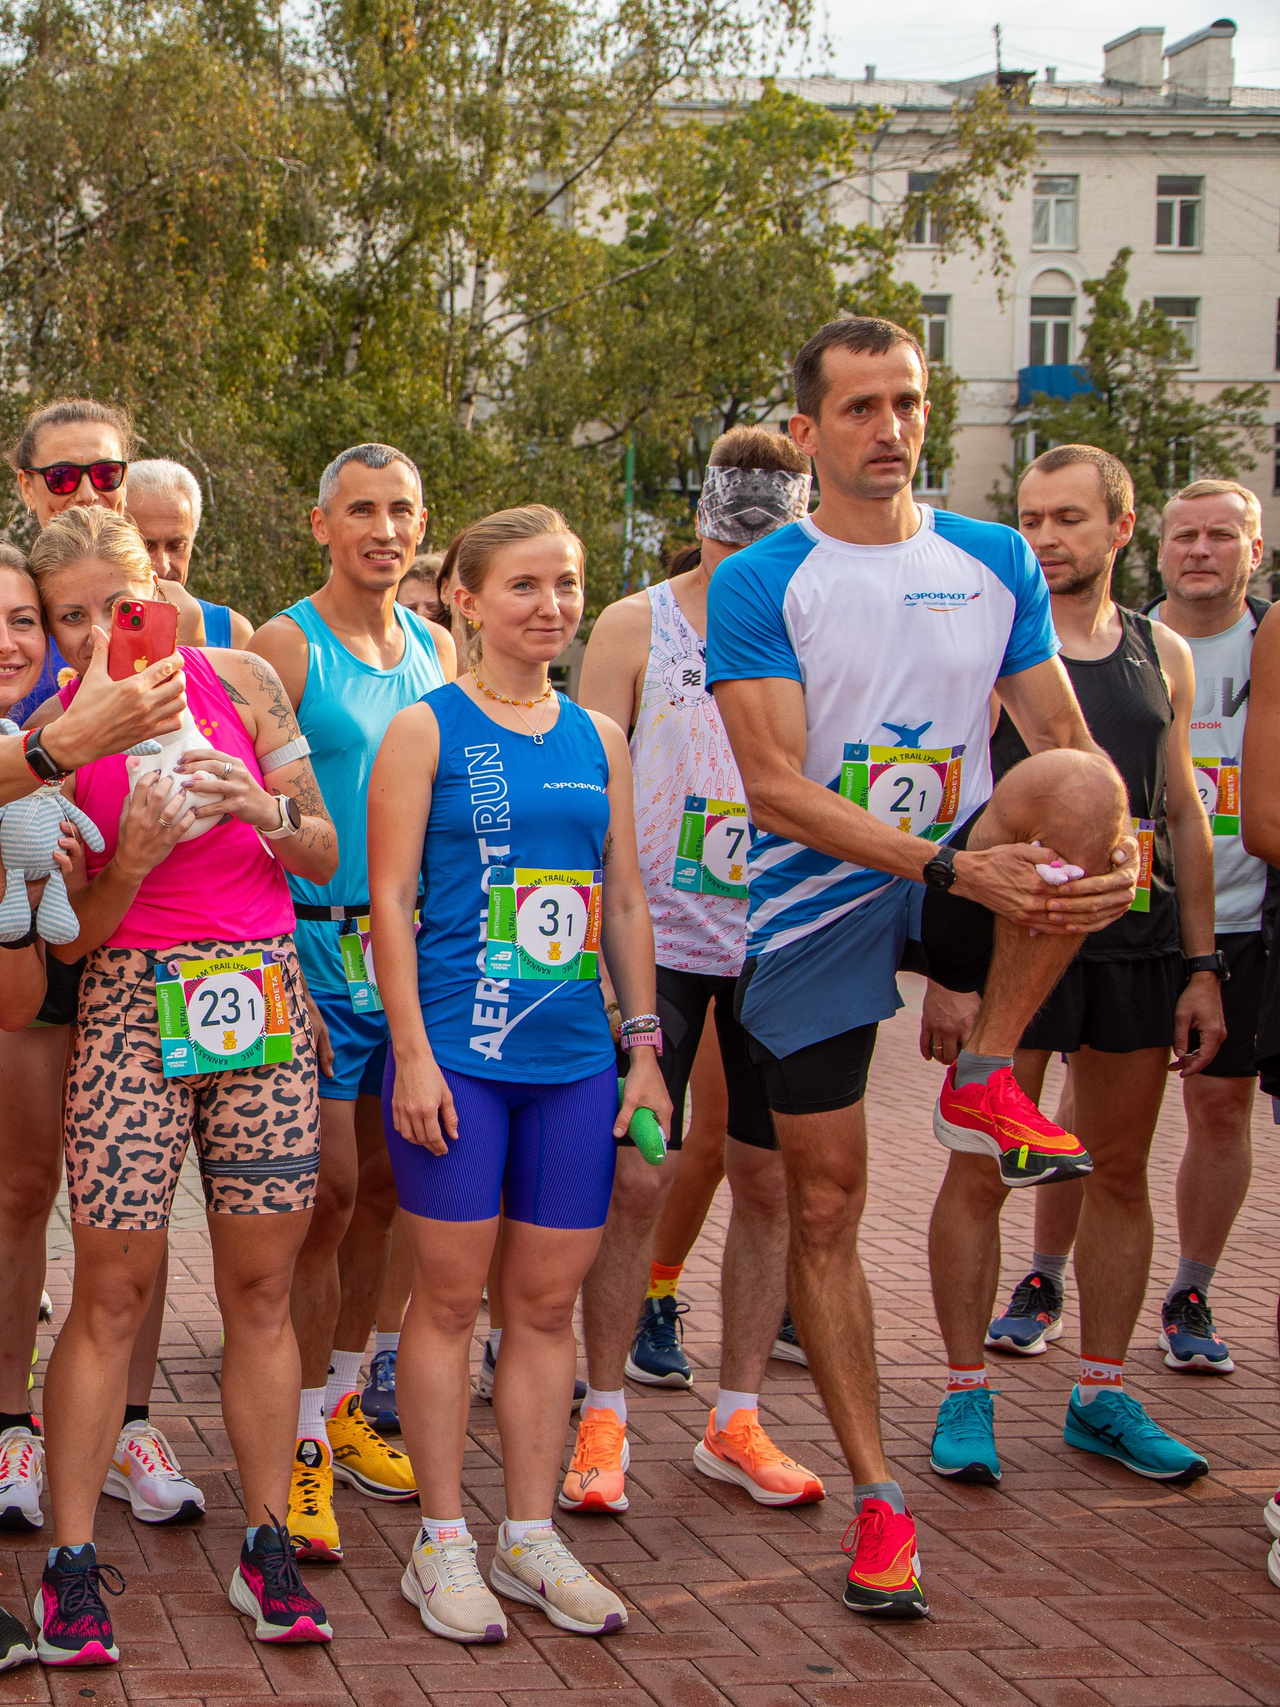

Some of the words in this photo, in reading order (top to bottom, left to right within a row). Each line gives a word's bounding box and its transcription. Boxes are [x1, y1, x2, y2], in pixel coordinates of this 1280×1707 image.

[903, 592, 967, 601] АЭРОФЛОТ
[872, 756, 898, 776] DREAM
[899, 753, 922, 761] TRAIL
[465, 743, 510, 834] RUN
[543, 782, 602, 792] АЭРОФЛОТ
[948, 768, 958, 815] ЭСТАФЕТА
[707, 809, 731, 826] DREAM
[1140, 840, 1149, 881] ЭСТАФЕТА
[518, 878, 542, 899] DREAM
[544, 874, 565, 882] TRAIL
[566, 876, 588, 899] LYSKOVO
[705, 874, 730, 892] KANNAS
[509, 910, 517, 932] TRAIL
[592, 896, 600, 943] ЭСТАФЕТА
[522, 955, 551, 975] KANNAS
[562, 965, 574, 974] ЛЕС
[186, 968, 209, 993] DREAM
[209, 962, 231, 972] TRAIL
[233, 962, 260, 983] LYSKOVO
[273, 975, 285, 1026] ЭСТАФЕТА
[255, 993, 272, 1051] ХИМКИНСКИЙ
[198, 1047, 228, 1065] KANNAS
[241, 1050, 255, 1062] ЛЕС
